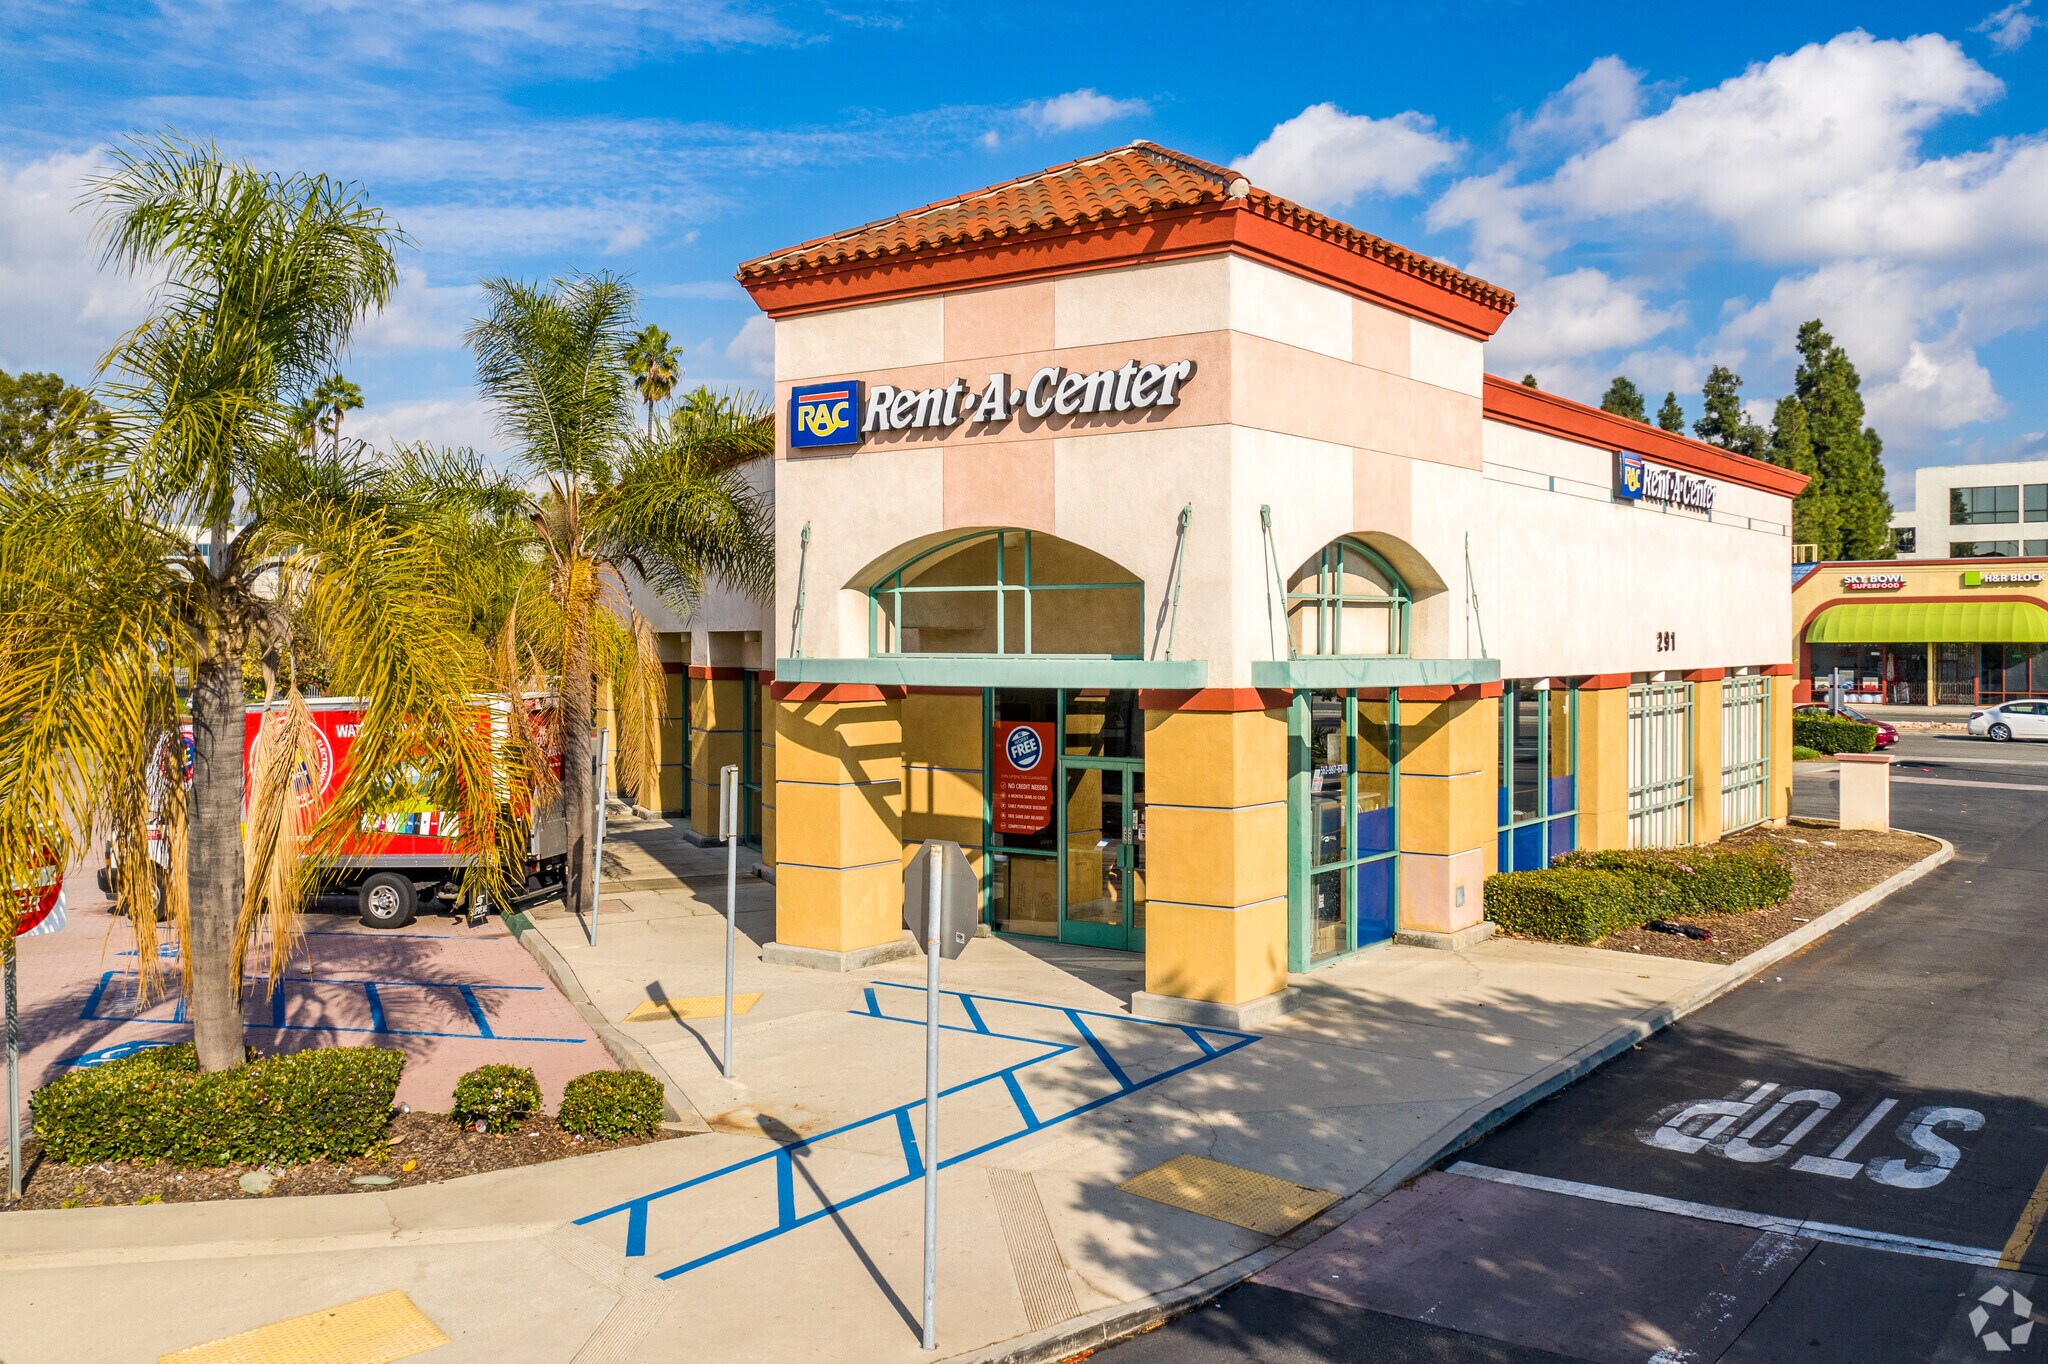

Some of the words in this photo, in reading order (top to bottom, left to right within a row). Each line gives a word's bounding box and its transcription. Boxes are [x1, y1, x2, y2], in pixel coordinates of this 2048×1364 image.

[797, 401, 850, 437] RAC
[1624, 466, 1641, 492] RAC
[1844, 575, 1869, 583] SKY
[1870, 575, 1907, 583] BOWL
[1984, 574, 2008, 582] H&R
[2010, 573, 2045, 582] BLOCK
[1656, 631, 1675, 652] 291
[1010, 738, 1037, 758] FREE
[1642, 1081, 1986, 1189] STOP
